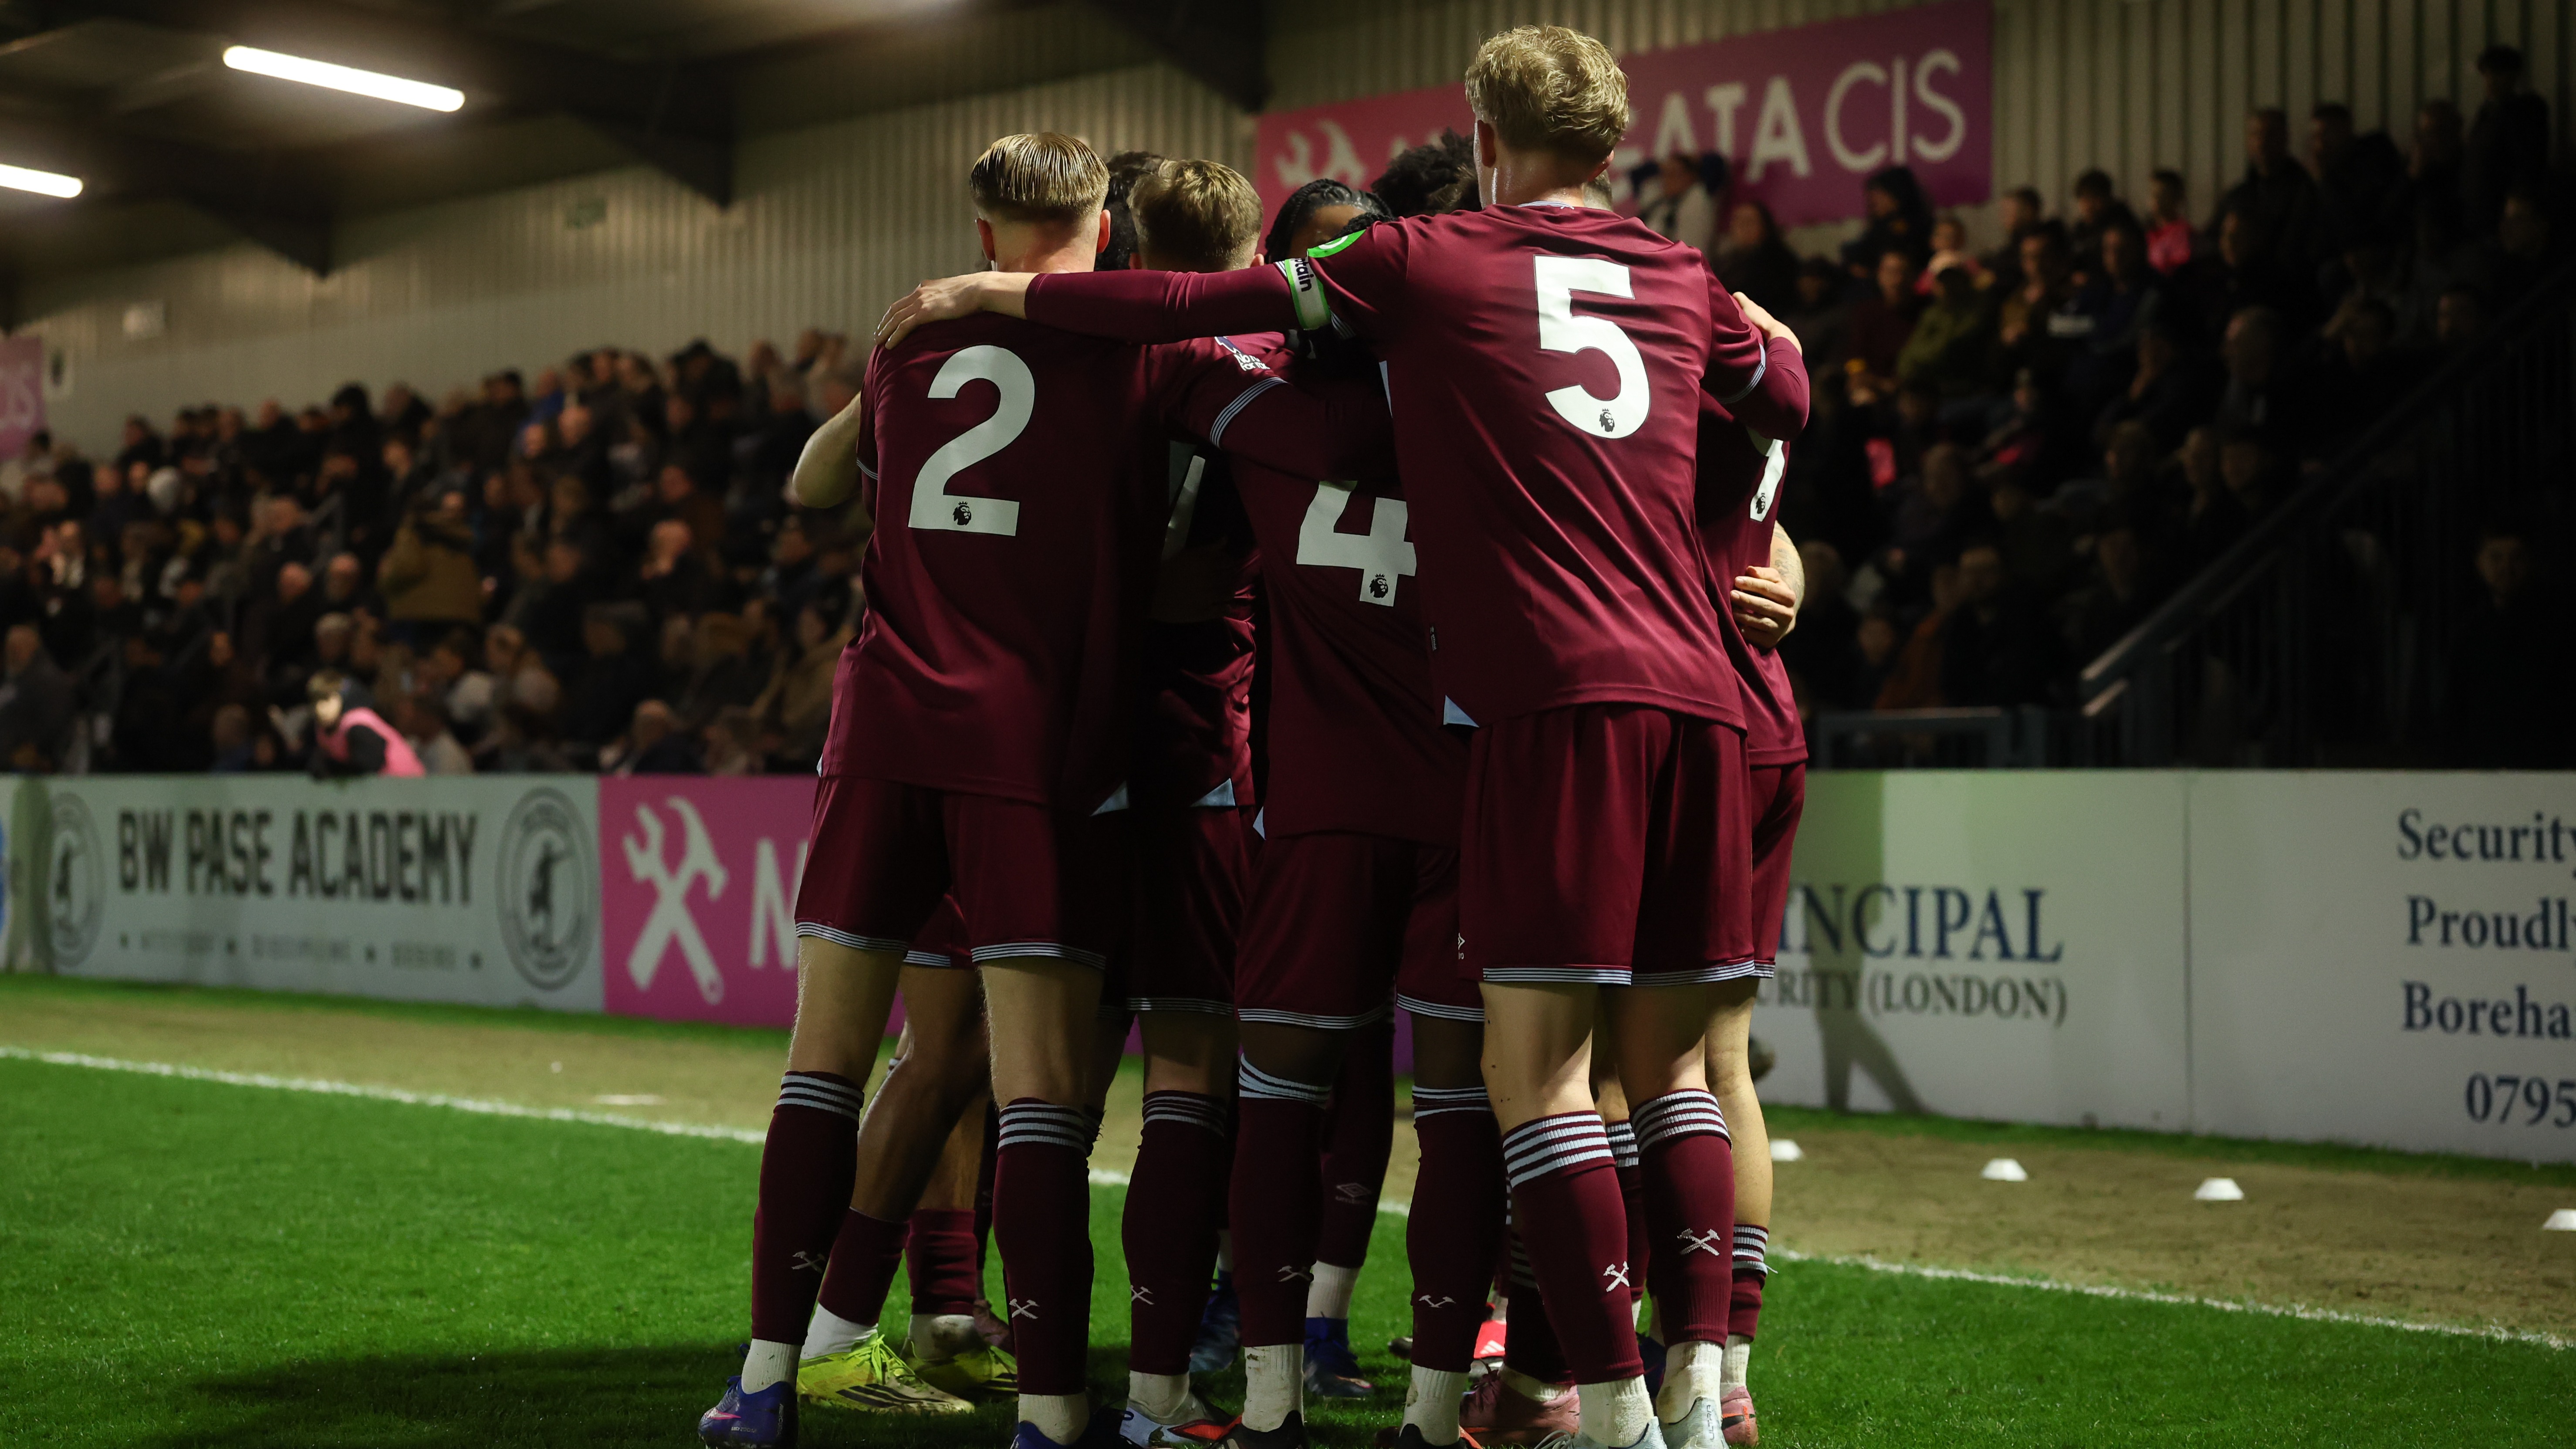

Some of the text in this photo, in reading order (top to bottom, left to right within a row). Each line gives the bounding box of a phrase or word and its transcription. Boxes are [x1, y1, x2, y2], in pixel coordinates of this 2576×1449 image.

[1823, 47, 1967, 173] CIS
[1291, 258, 1315, 292] ptain
[1533, 255, 1650, 439] 5
[908, 344, 1035, 536] 2
[1296, 480, 1417, 607] 4
[118, 808, 477, 905] BW PASE ACADEMY
[1777, 882, 2063, 962] INCIPAL
[2407, 894, 2576, 950] Proudl
[1868, 973, 2067, 1027] (LONDON)
[2402, 980, 2576, 1039] Boreha
[2466, 1072, 2576, 1128] 0795
[1706, 1405, 1715, 1440] ULTRA
